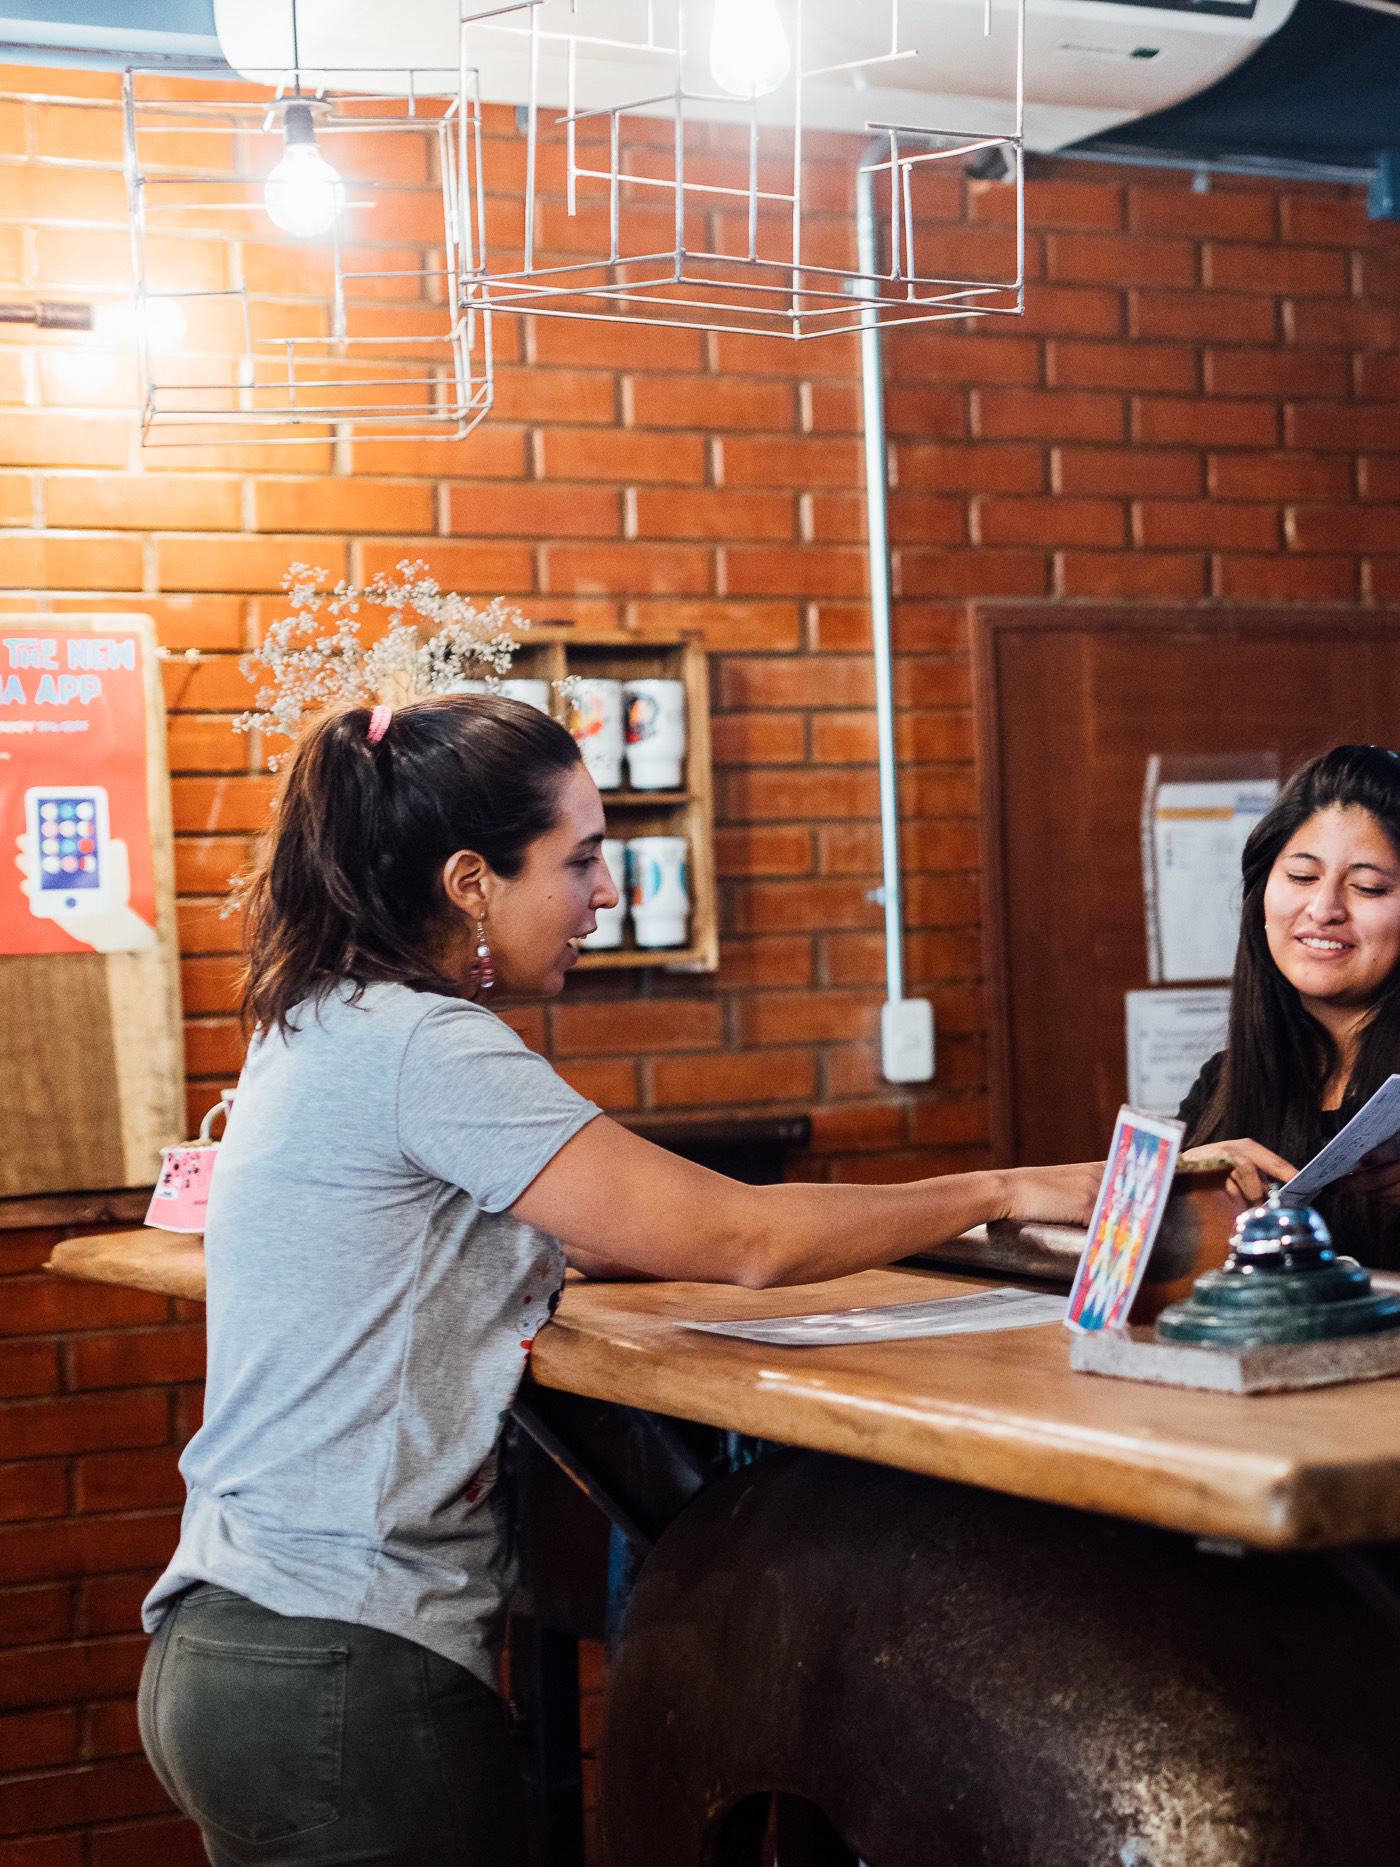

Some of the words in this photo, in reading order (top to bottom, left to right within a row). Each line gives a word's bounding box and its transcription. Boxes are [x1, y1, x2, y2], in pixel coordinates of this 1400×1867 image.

[3, 638, 58, 670] THE
[67, 638, 136, 671] NEW
[34, 673, 102, 705] APP
